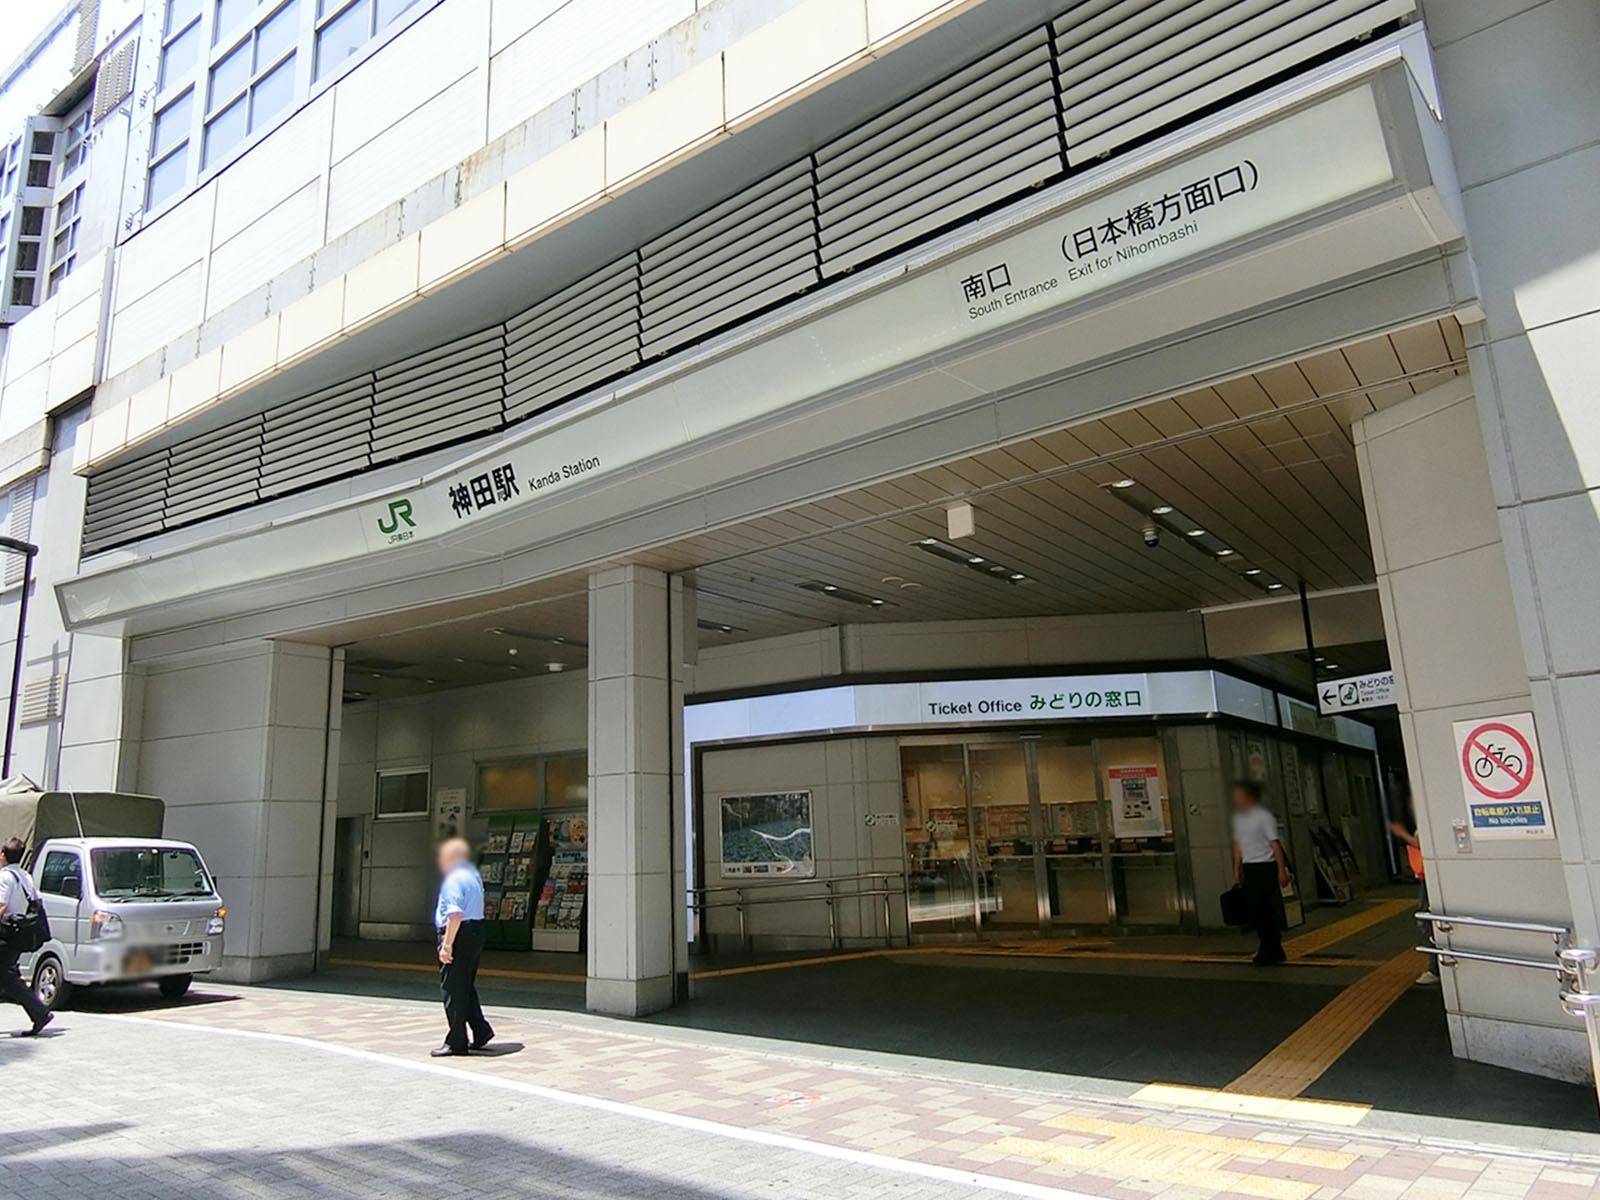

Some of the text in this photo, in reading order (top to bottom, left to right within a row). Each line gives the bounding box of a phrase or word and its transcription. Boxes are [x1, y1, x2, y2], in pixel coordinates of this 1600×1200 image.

[961, 263, 1012, 303] 南口
[969, 220, 1199, 320] South Entrance Exit for Nihombashi
[449, 463, 520, 519] 神田駅
[528, 457, 601, 491] Kanda Station
[377, 498, 416, 534] JR
[928, 690, 1141, 715] Ticket Office みどりの窓口
[1488, 816, 1528, 825] No bicycles
